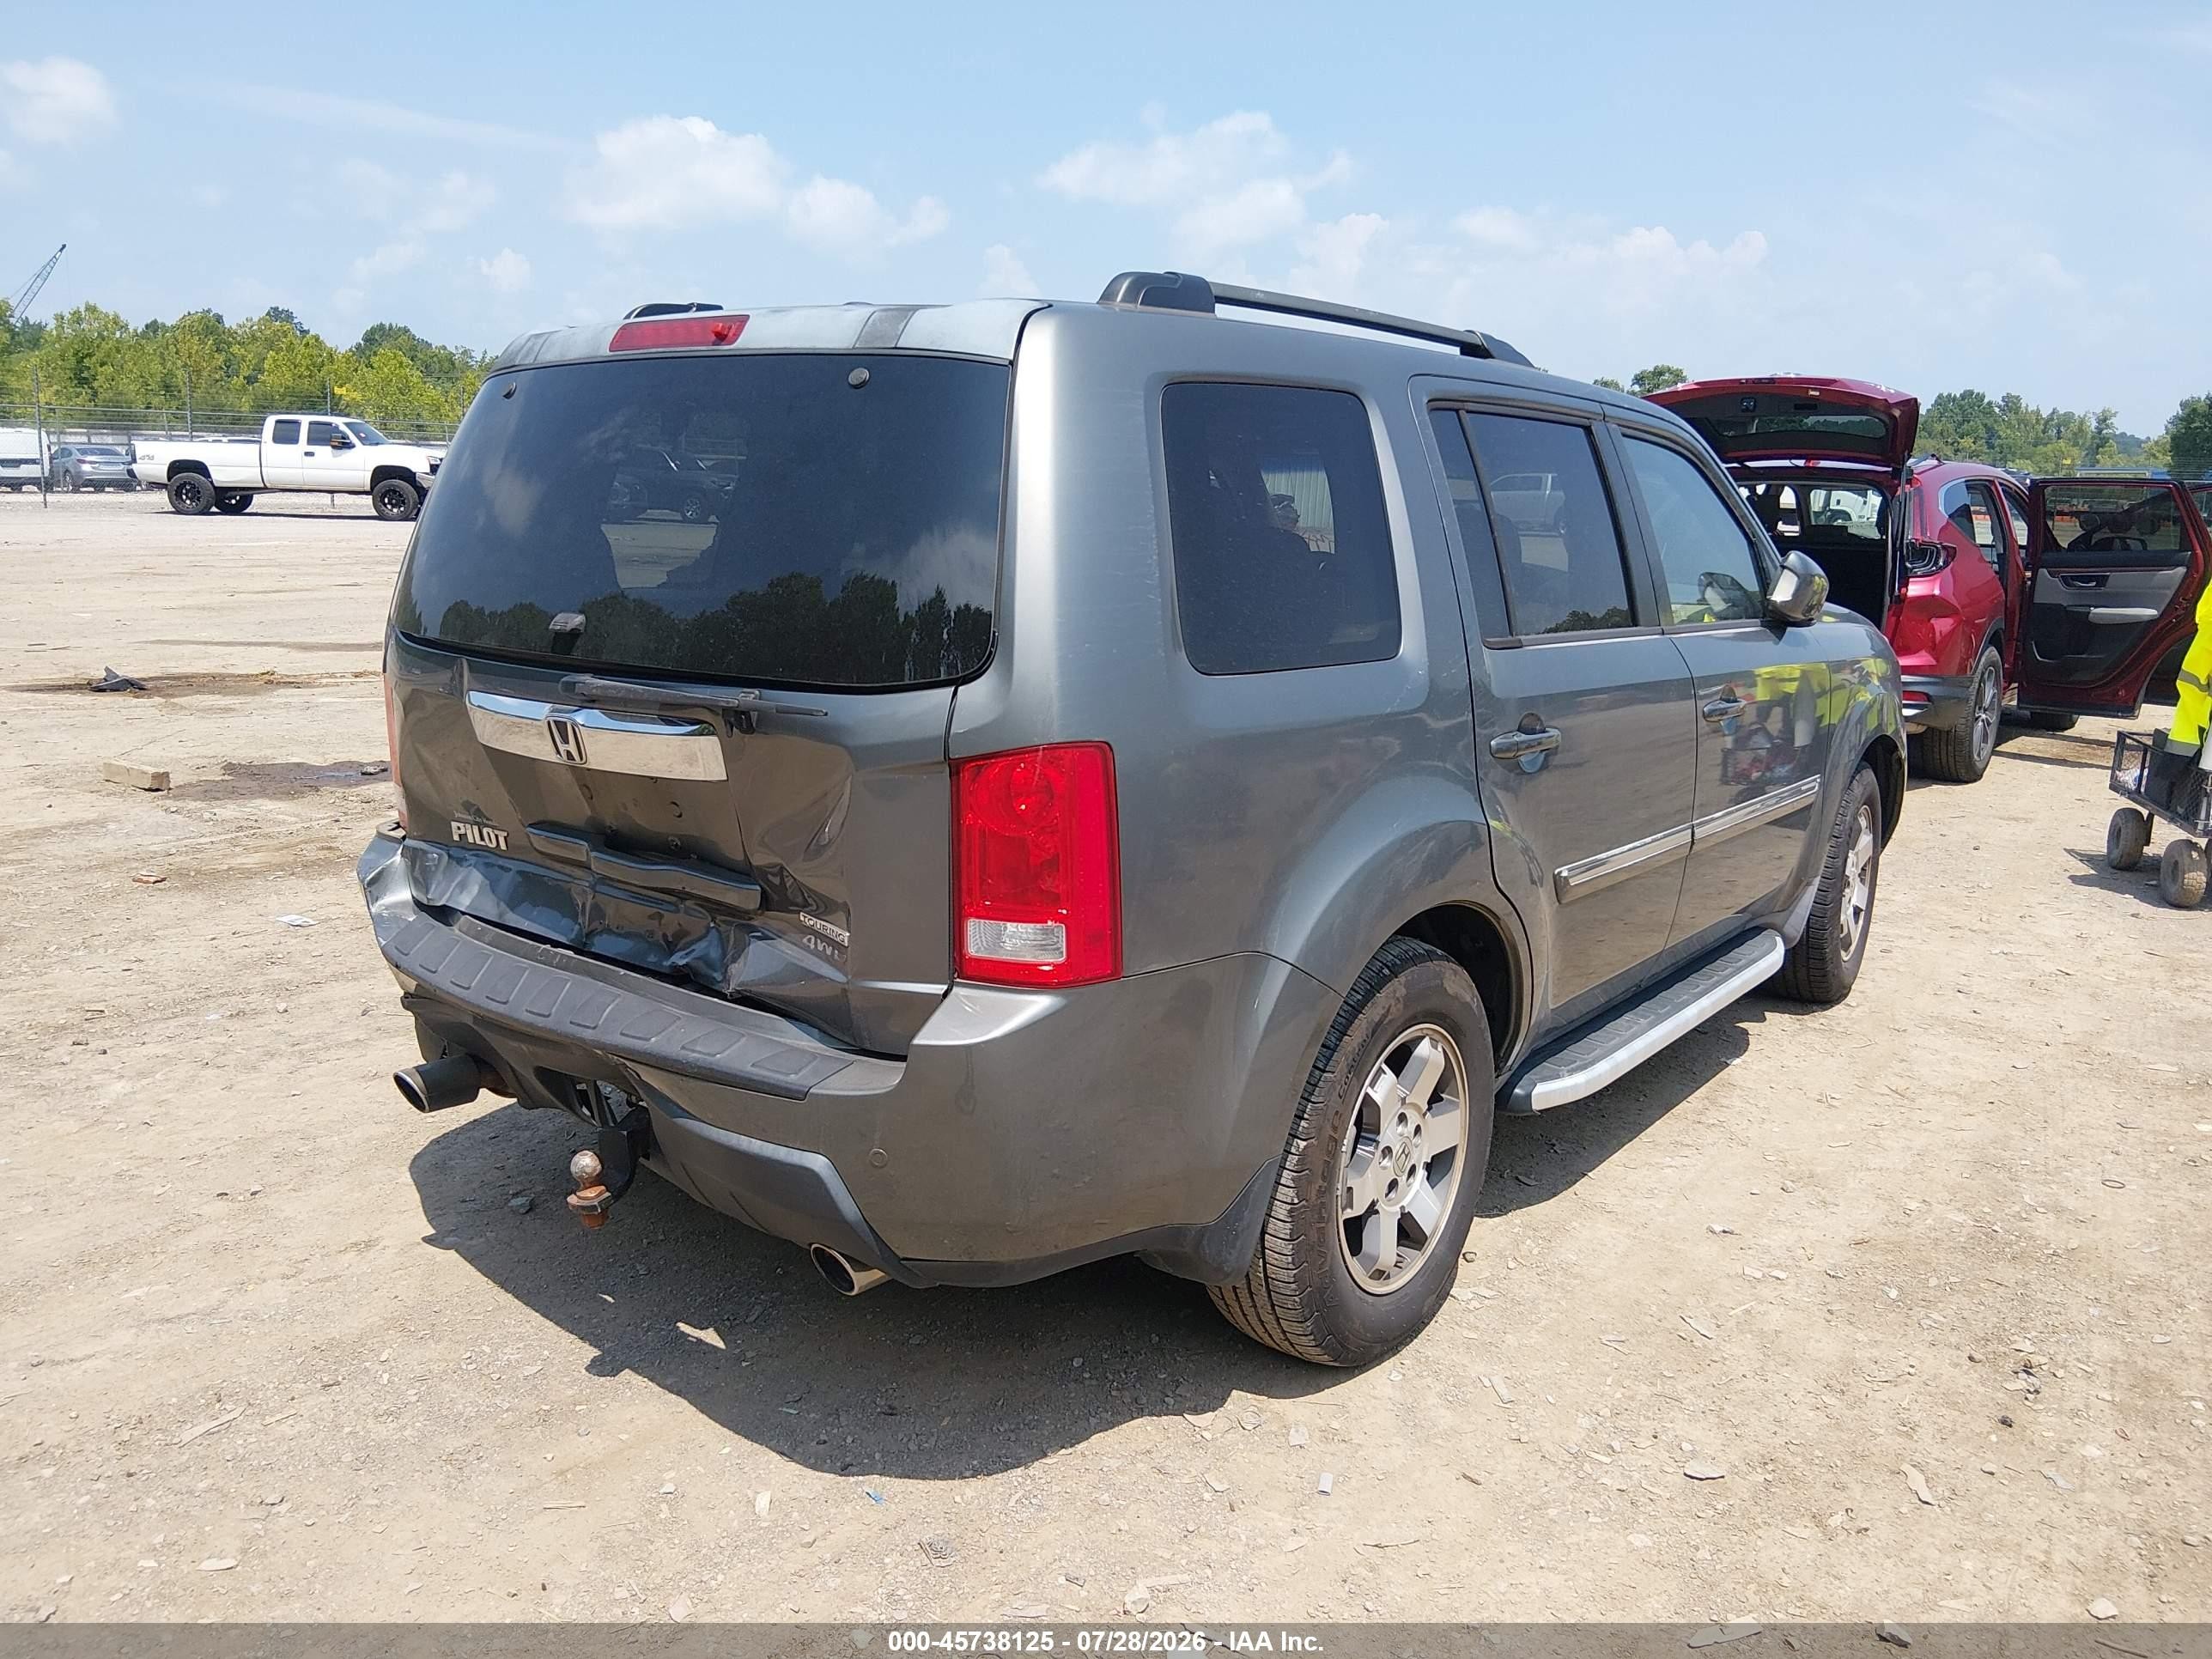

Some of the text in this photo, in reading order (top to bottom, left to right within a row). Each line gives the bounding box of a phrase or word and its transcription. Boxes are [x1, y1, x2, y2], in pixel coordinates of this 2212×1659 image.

[450, 821, 508, 851] PILOT
[799, 913, 848, 945] TOURING
[1339, 1032, 1370, 1101] Control
